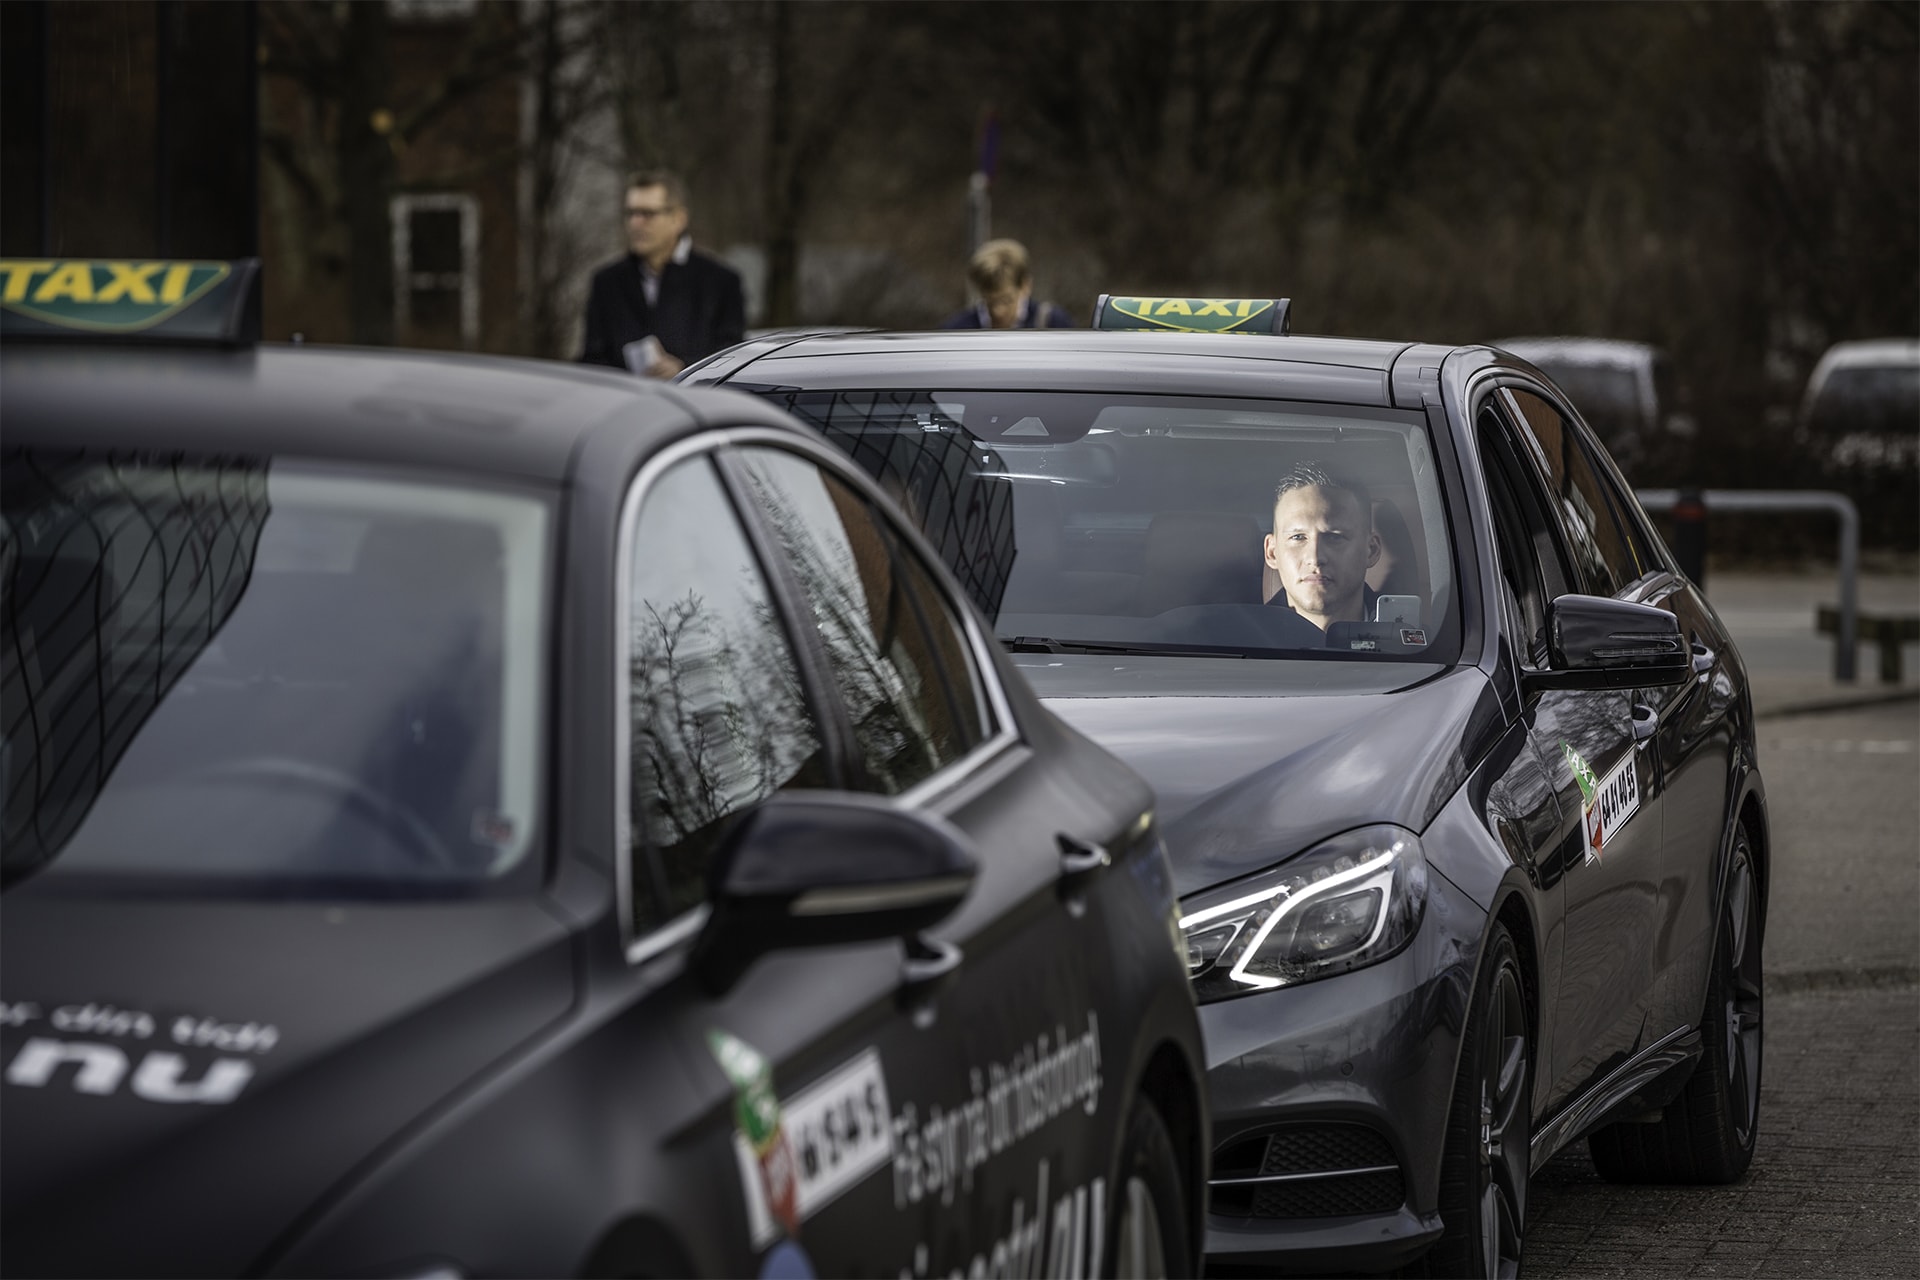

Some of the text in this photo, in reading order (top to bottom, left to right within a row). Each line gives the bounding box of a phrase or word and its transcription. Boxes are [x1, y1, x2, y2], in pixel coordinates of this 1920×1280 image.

[0, 261, 193, 304] TAXI
[1132, 298, 1253, 317] TAXI
[5, 1036, 256, 1104] nu
